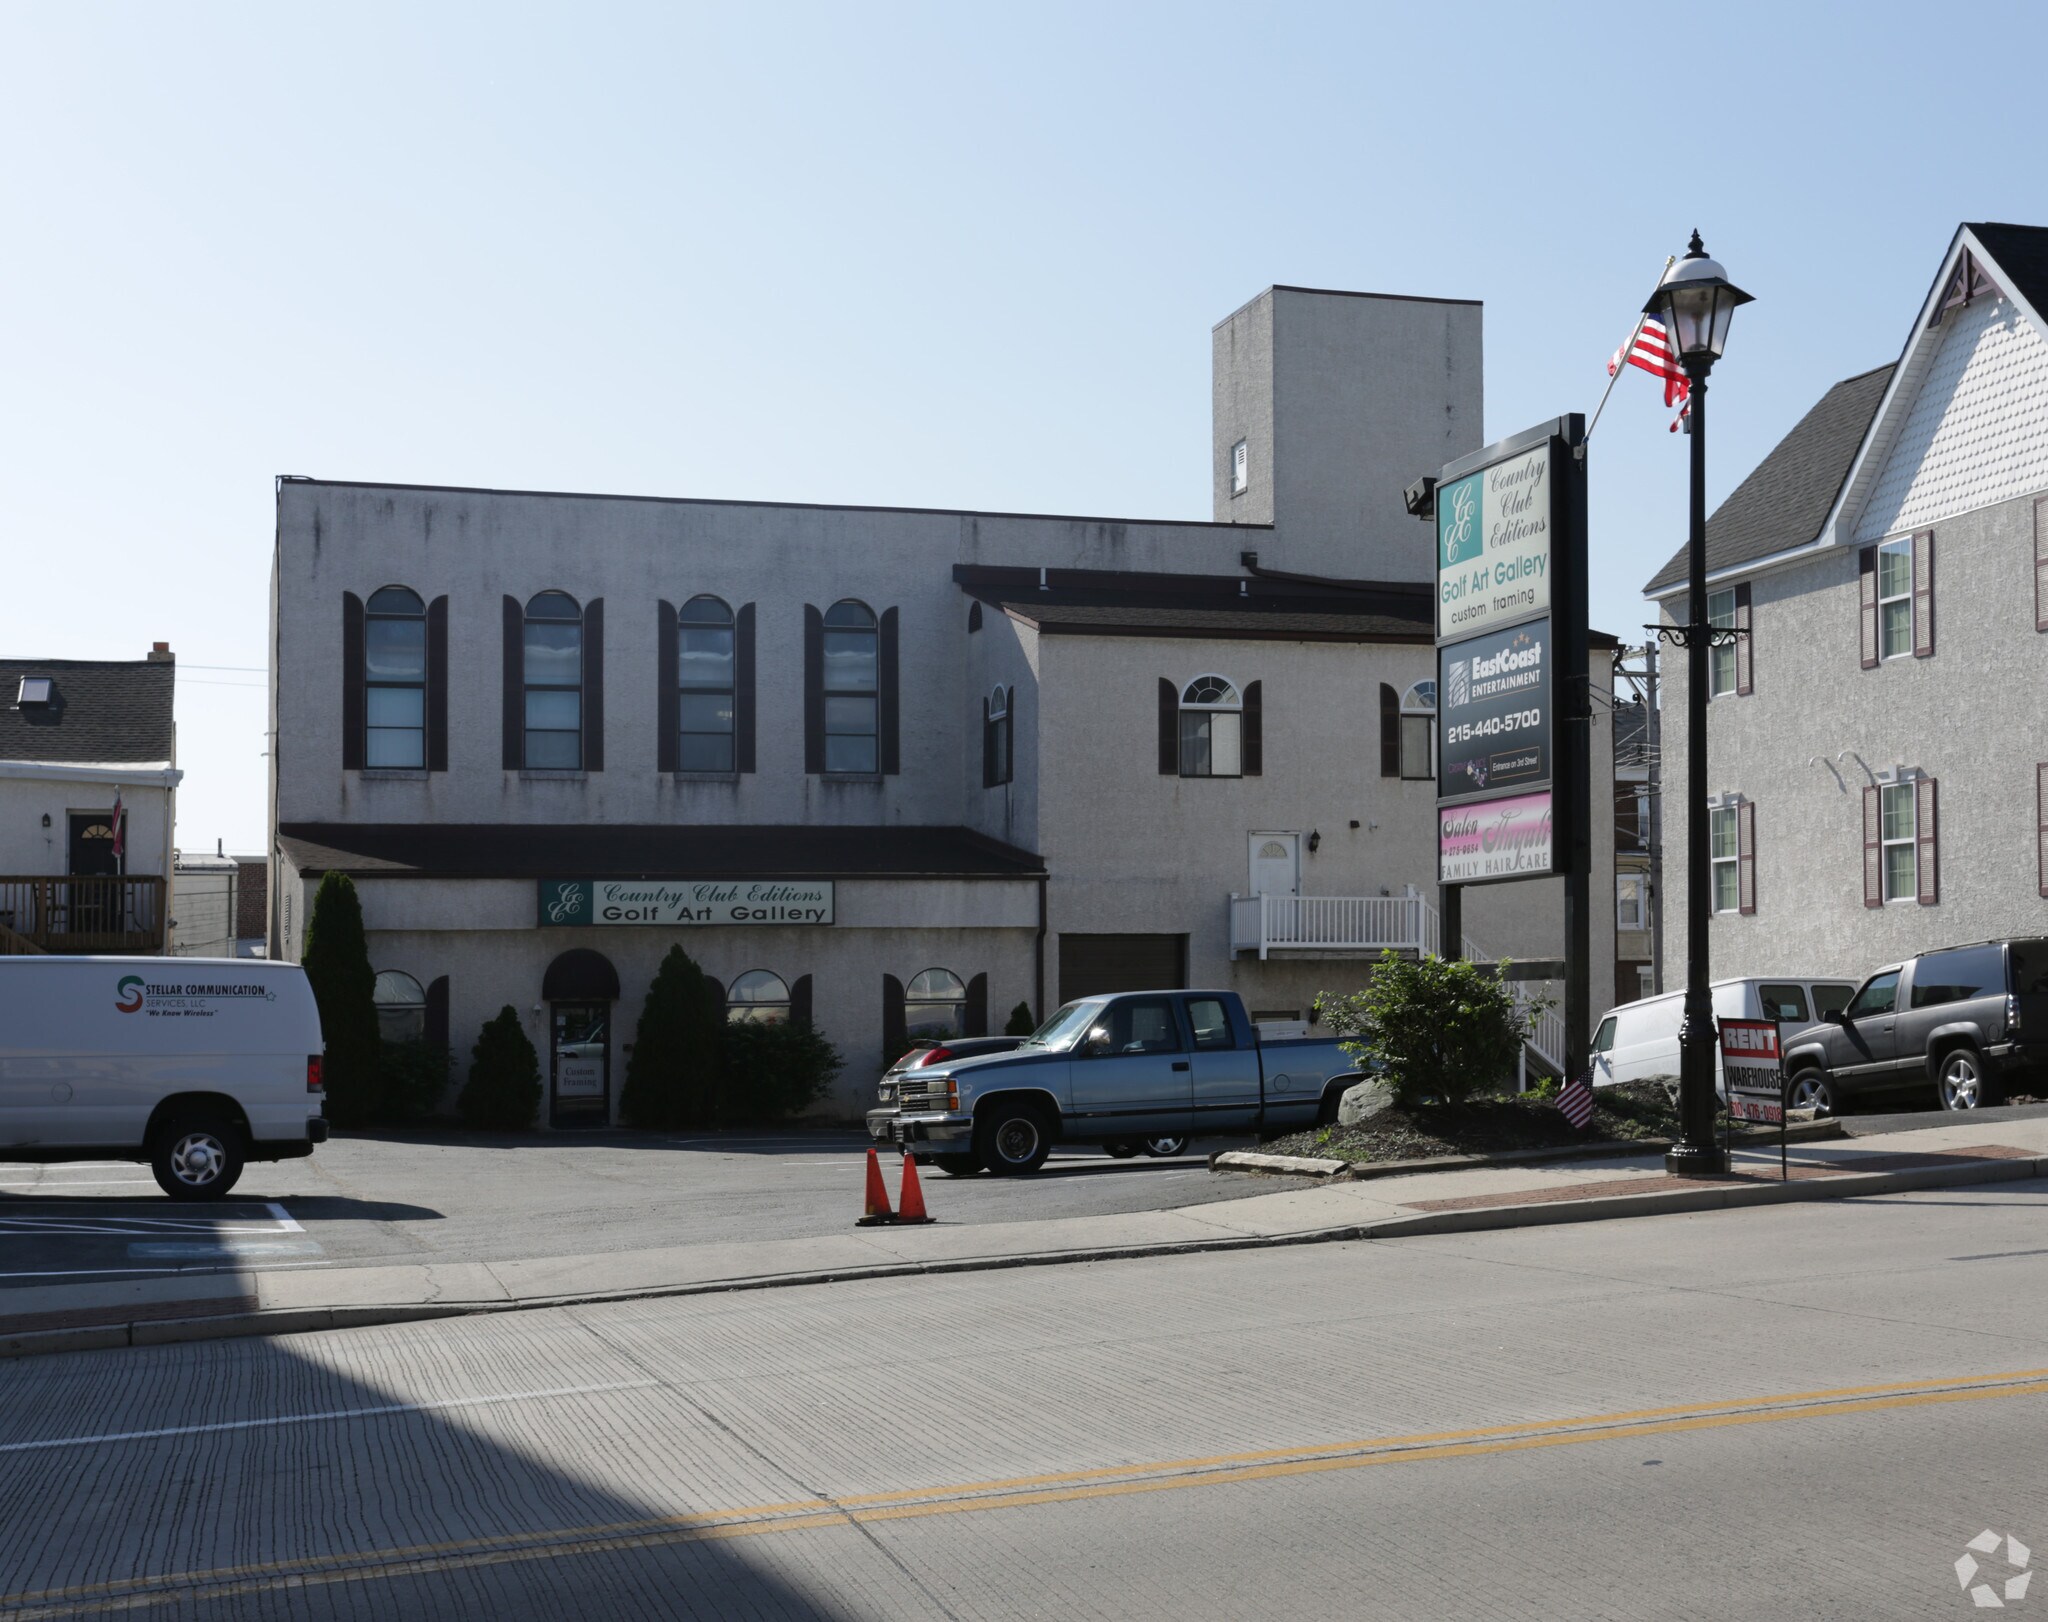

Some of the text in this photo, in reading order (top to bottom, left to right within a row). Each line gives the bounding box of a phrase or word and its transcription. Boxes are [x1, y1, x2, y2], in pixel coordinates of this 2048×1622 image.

[1490, 457, 1545, 493] Country
[1500, 485, 1533, 518] Club
[1490, 516, 1546, 549] Editions
[1441, 553, 1547, 603] Golf Art Gallery
[1451, 588, 1535, 624] custom framing
[1472, 670, 1541, 698] ENTERTAINMENT
[1448, 708, 1540, 744] 215-440-5700
[1492, 761, 1511, 772] Entrance
[1510, 761, 1516, 769] on
[1516, 758, 1524, 767] 3rd
[1524, 756, 1538, 766] Street
[1443, 810, 1478, 839] Salon
[1442, 852, 1548, 879] FAMILY HAIR CARE
[603, 884, 823, 909] Country Club Editions
[602, 906, 826, 923] Golf Art Gallery
[146, 984, 265, 996] STELLAR COMMUNICATION
[162, 1009, 181, 1017] Know
[191, 999, 206, 1008] LLC
[1723, 1028, 1776, 1051] RENT
[563, 1077, 597, 1088] Framing
[565, 1067, 595, 1076] Custom
[1726, 1066, 1781, 1089] WAREHOUSE
